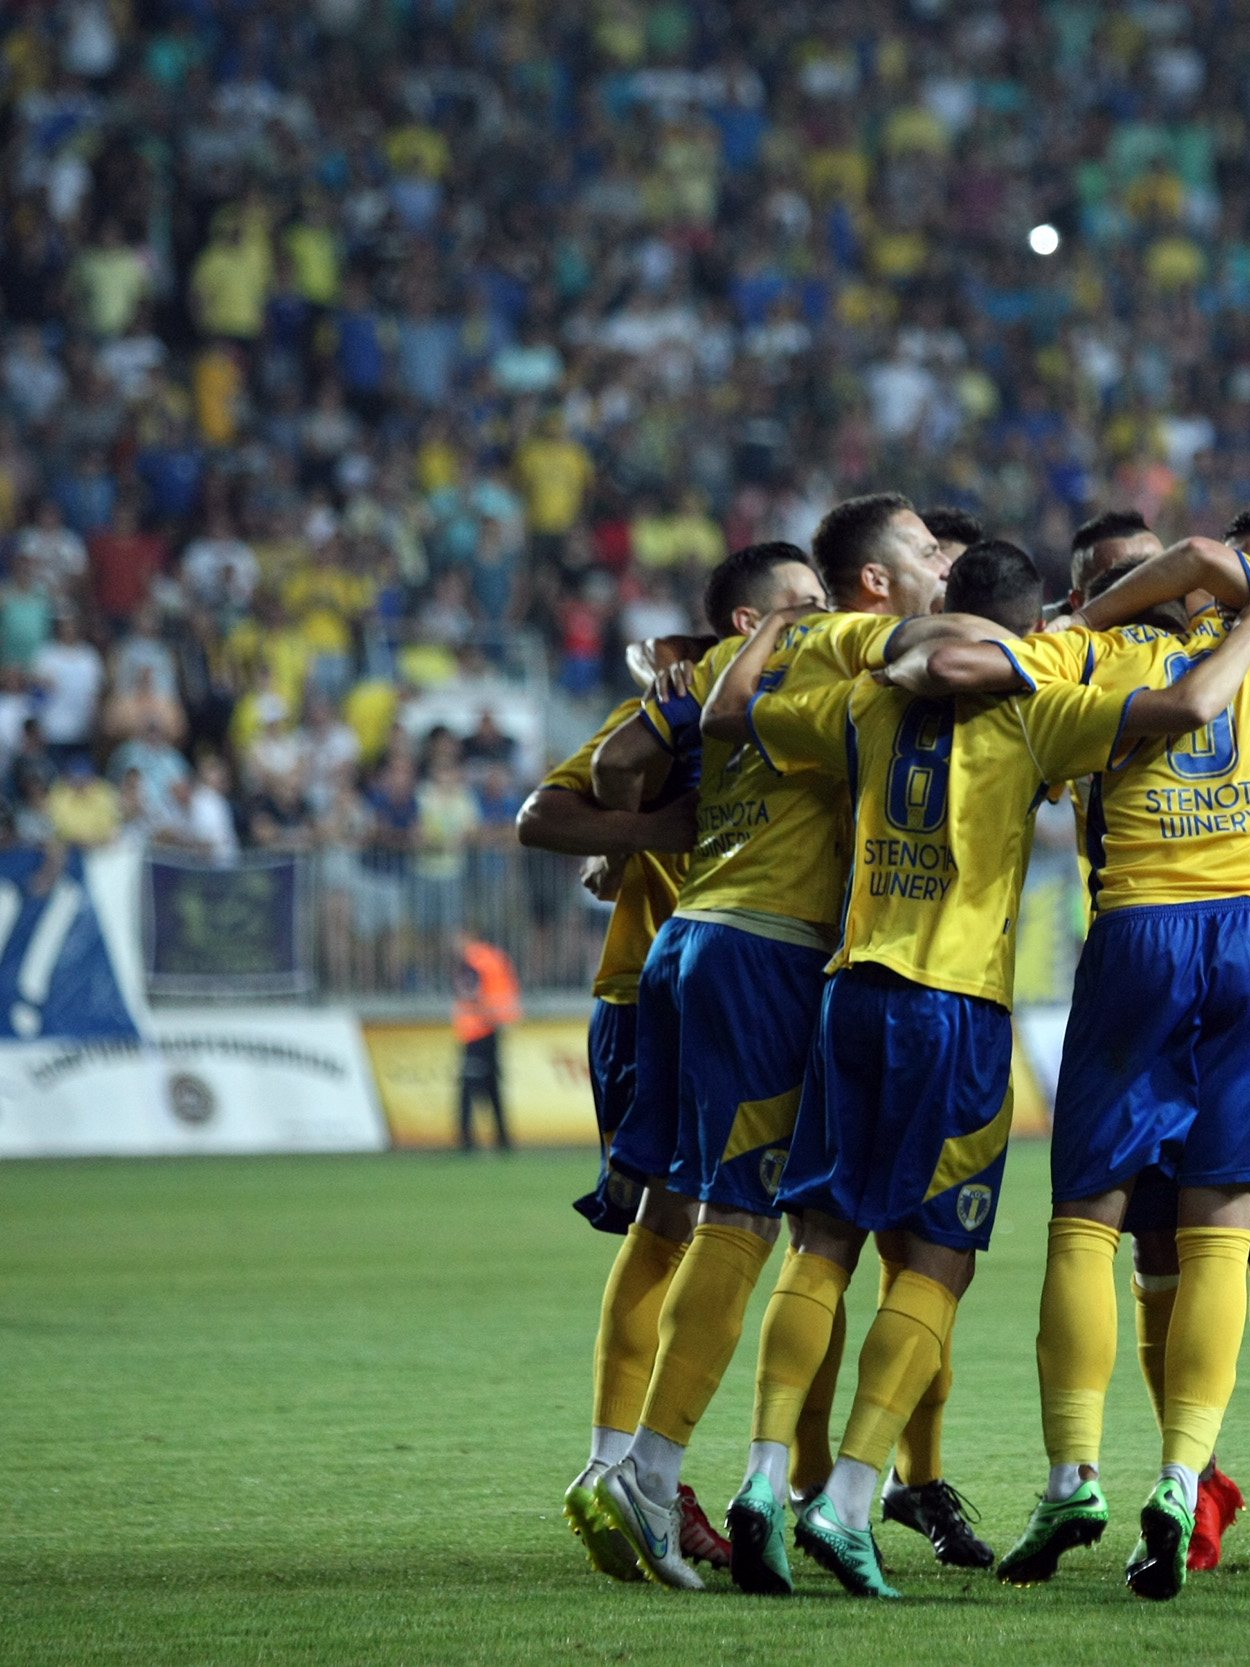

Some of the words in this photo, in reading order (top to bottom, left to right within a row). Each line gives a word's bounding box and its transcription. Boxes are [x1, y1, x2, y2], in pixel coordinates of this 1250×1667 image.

[885, 696, 955, 834] 8
[864, 839, 958, 872] STENOTA
[869, 871, 952, 901] WINERY
